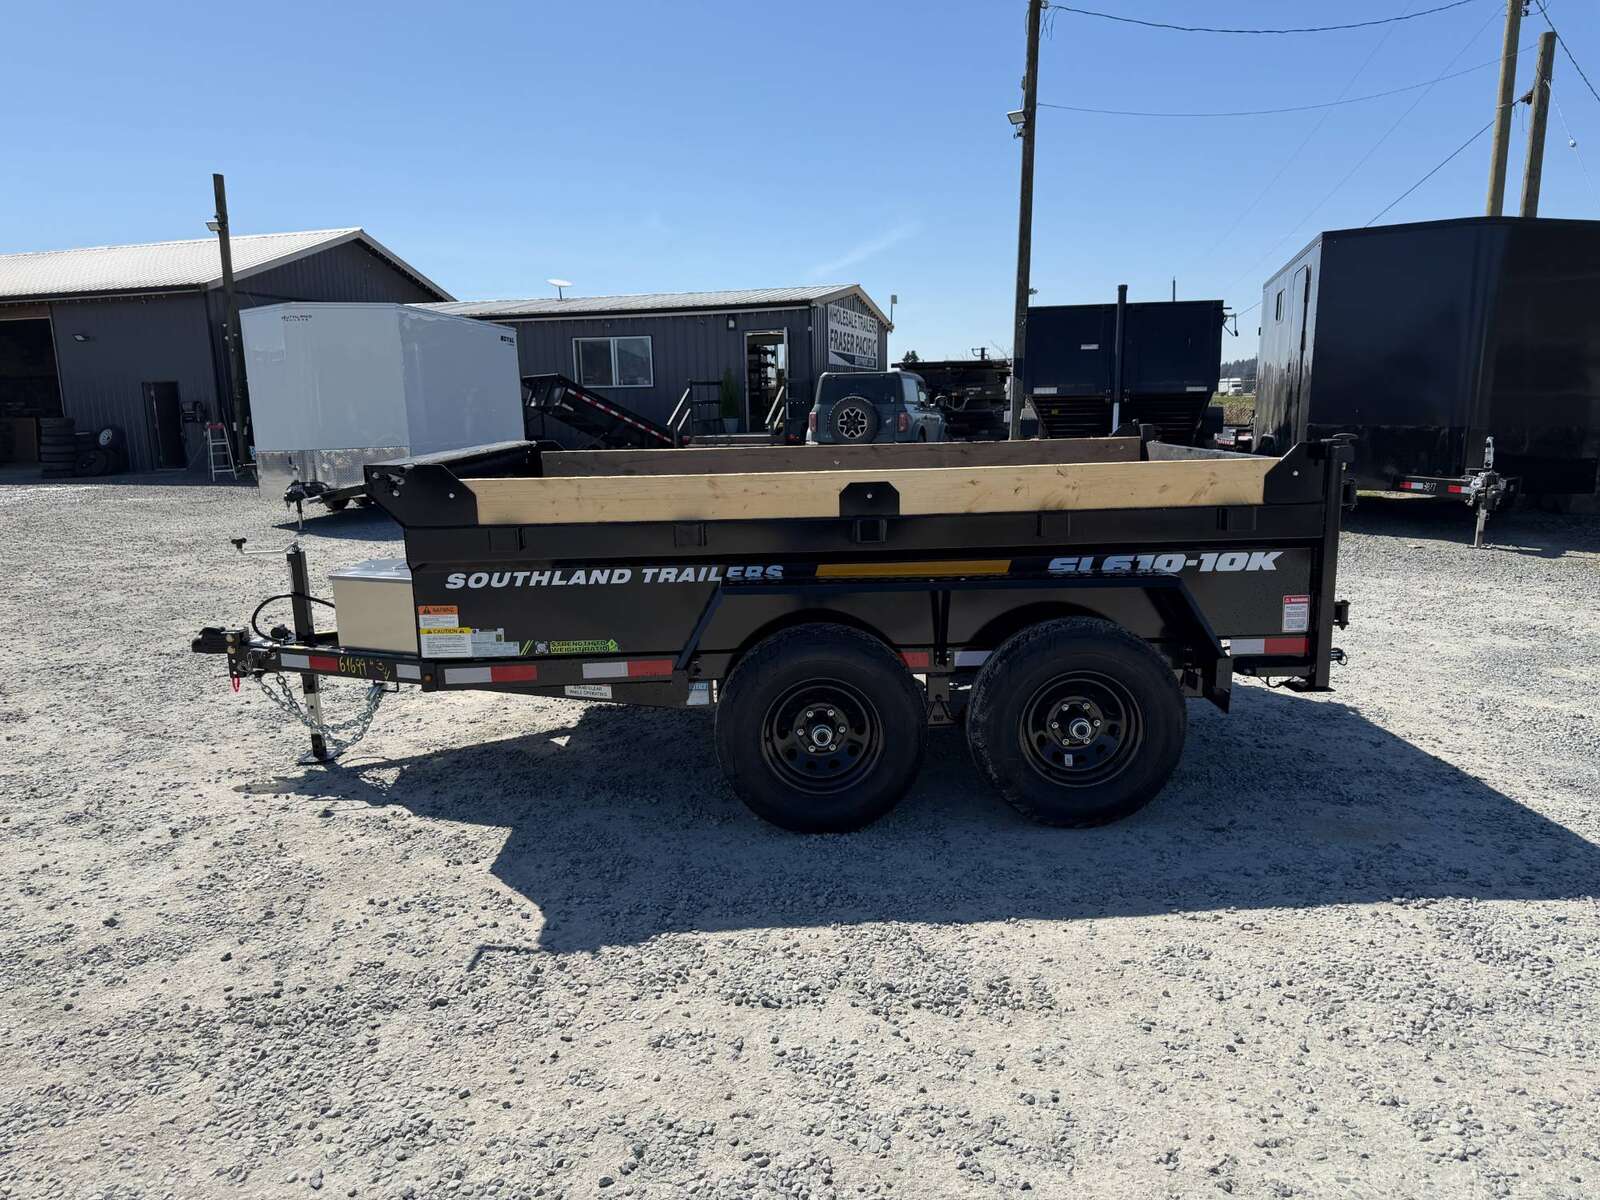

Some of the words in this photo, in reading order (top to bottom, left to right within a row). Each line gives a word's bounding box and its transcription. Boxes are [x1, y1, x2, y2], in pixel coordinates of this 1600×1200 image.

[830, 328, 854, 353] FRASER
[855, 335, 877, 357] PACIFIC
[1047, 551, 1285, 573] SL610-10K
[445, 568, 633, 590] SOUTHLAND
[641, 564, 784, 584] TRAILERS
